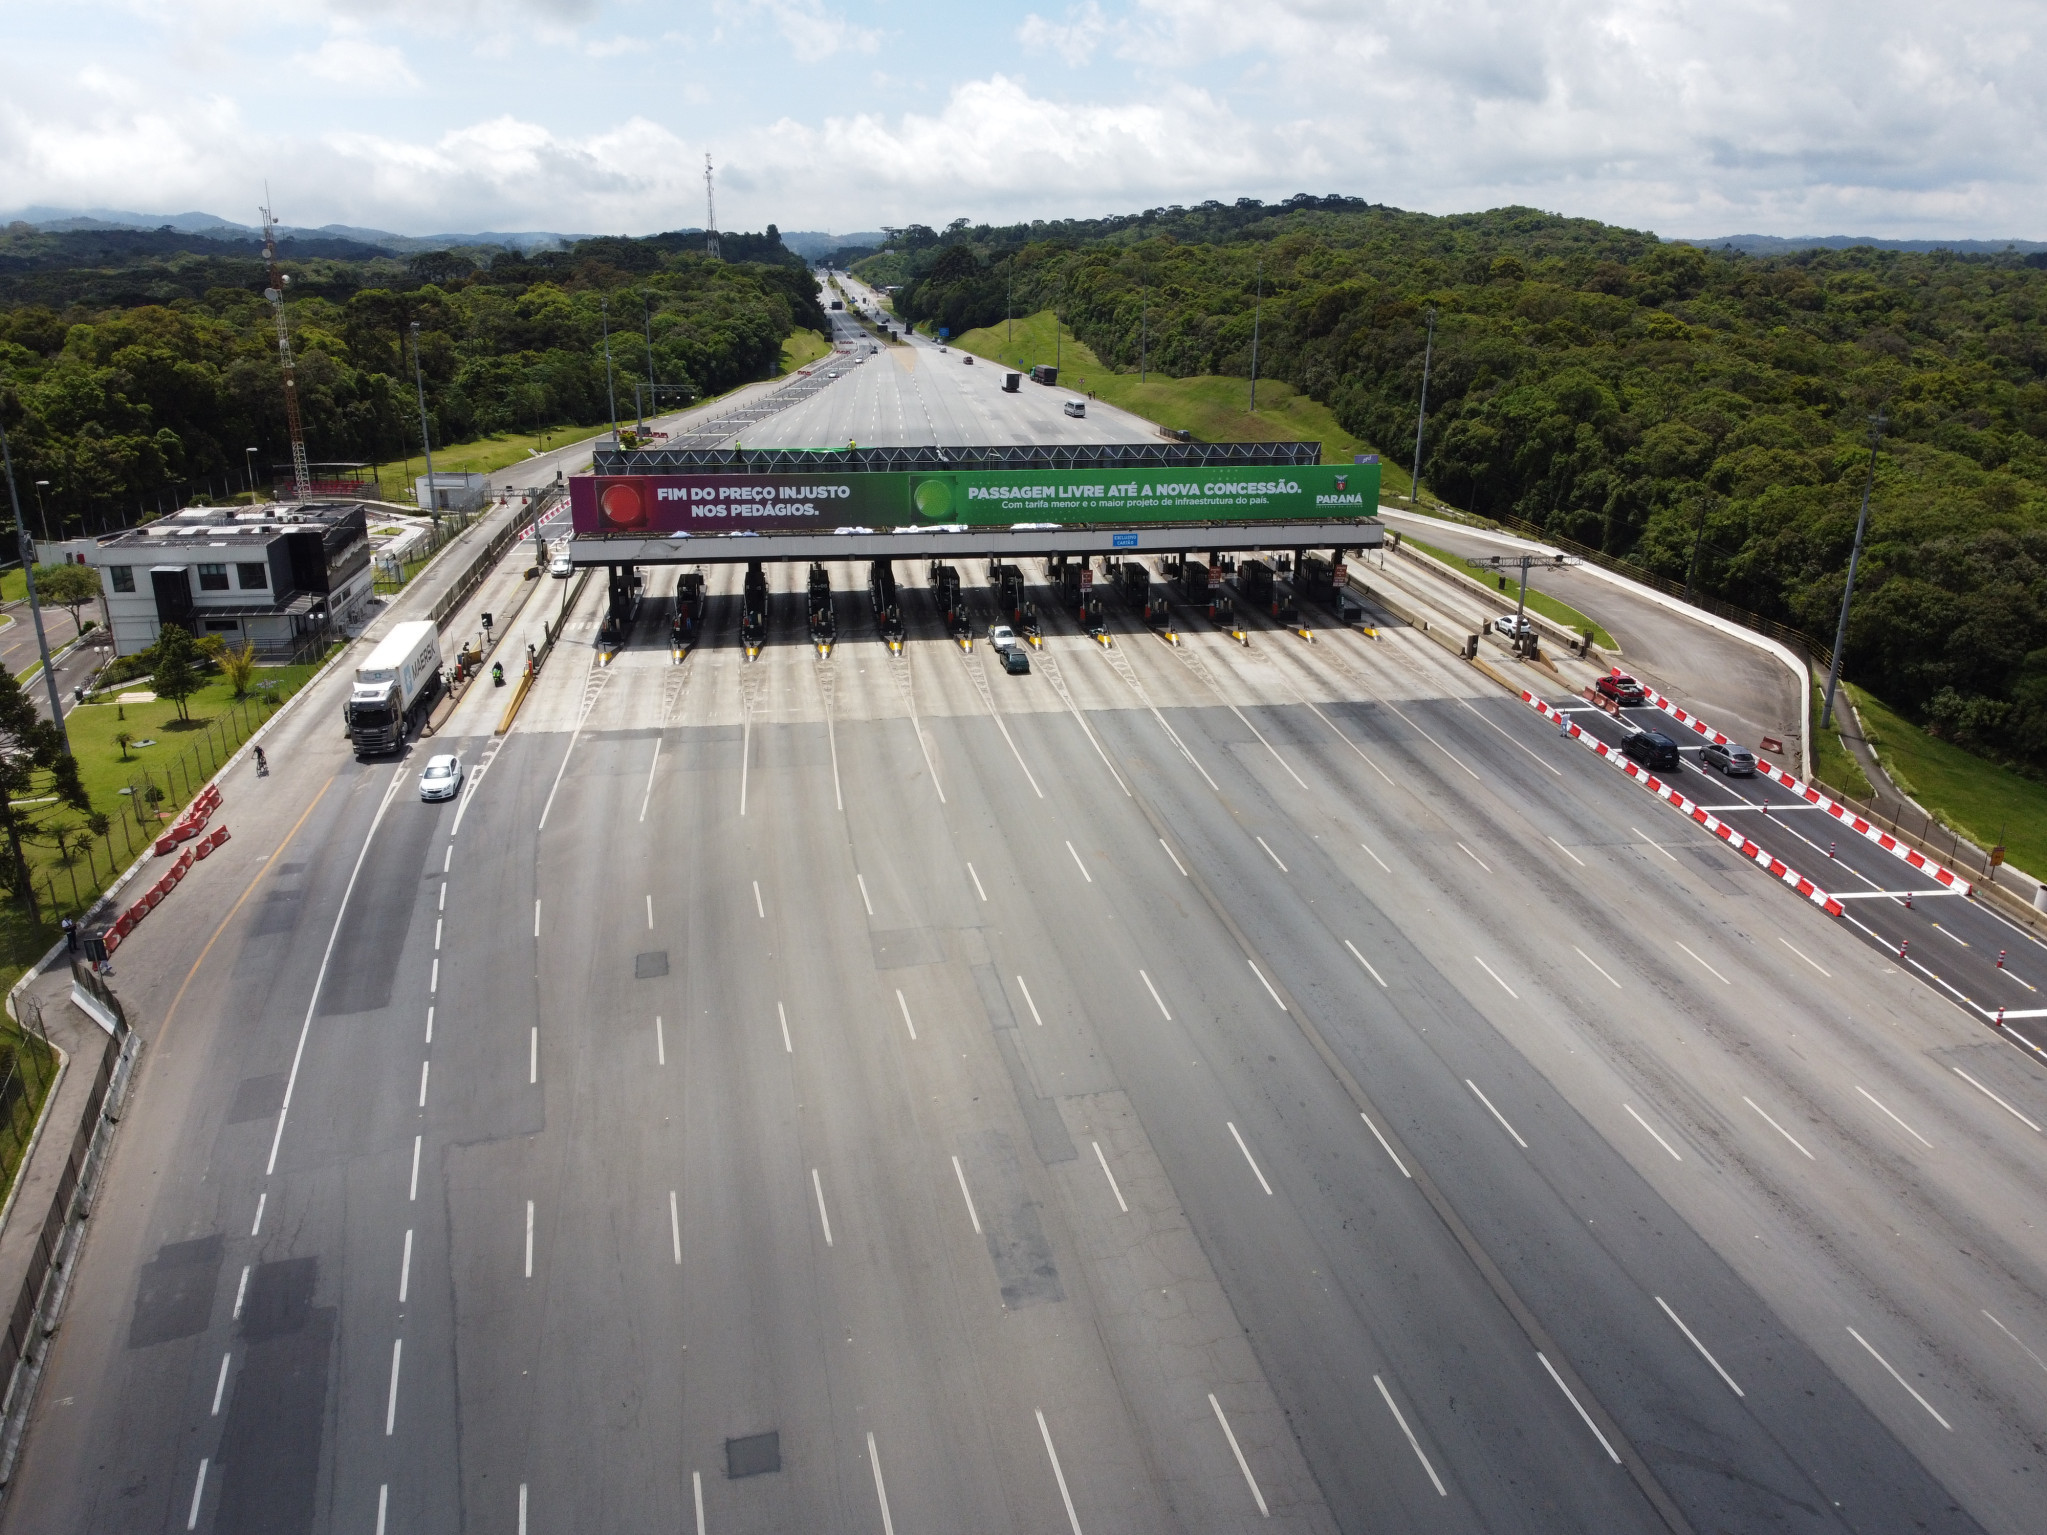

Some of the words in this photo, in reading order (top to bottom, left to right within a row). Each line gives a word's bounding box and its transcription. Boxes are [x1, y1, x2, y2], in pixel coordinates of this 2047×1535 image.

[657, 488, 688, 500] FIM
[690, 487, 716, 500] DO
[719, 486, 776, 502] PREÇO
[779, 486, 850, 499] INJUSTO
[968, 486, 1056, 500] PASSAGEM
[1059, 484, 1105, 498] LIVRE
[1108, 482, 1138, 497] ATÉ
[1140, 484, 1152, 496] A
[1156, 484, 1200, 496] NOVA
[1204, 479, 1302, 494] CONCESSÃO.
[1002, 500, 1022, 508] Com
[1026, 500, 1048, 508] tarifa
[1099, 499, 1124, 507] maior
[1126, 498, 1158, 508] projeto
[1175, 497, 1234, 506] infraestrutura
[1250, 496, 1270, 506] país.
[1316, 492, 1362, 504] PARANÁ
[692, 504, 728, 517] NOS
[731, 500, 820, 516] PEDÁGIOS.
[412, 638, 436, 681] MAERSK
